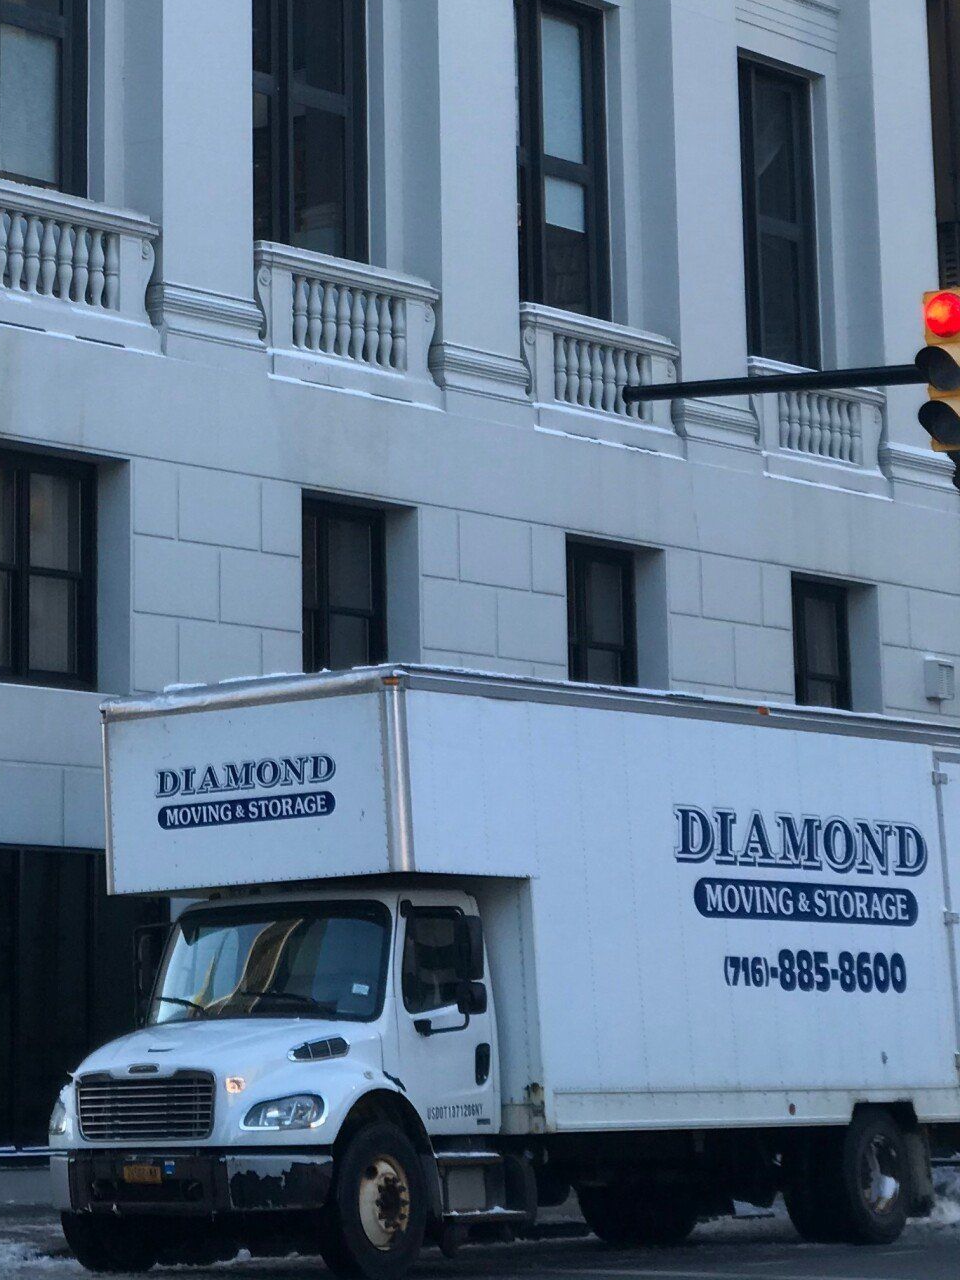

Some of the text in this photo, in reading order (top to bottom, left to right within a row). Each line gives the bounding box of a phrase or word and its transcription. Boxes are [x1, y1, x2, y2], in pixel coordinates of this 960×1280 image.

[155, 752, 336, 798] DIAMOND
[166, 794, 328, 827] MOVING & STORAGE
[673, 804, 928, 876] DIAMOND
[705, 884, 910, 921] MOVING & STORAGE
